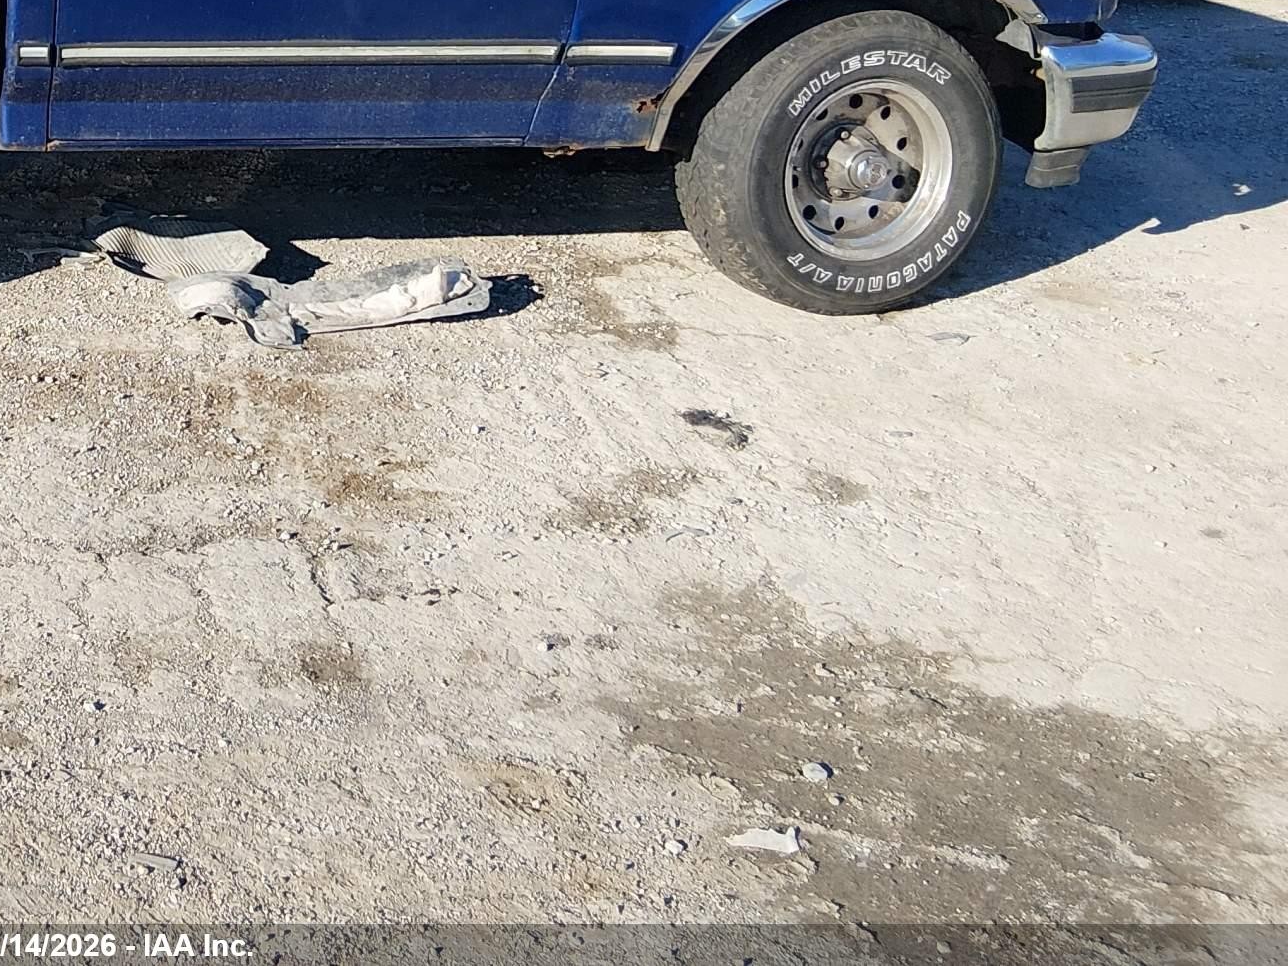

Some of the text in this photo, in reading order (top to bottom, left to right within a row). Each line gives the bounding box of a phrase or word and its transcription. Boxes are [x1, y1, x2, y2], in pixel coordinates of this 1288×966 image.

[789, 49, 952, 117] MILESTAR
[786, 210, 972, 293] PATAGONIA A/T
